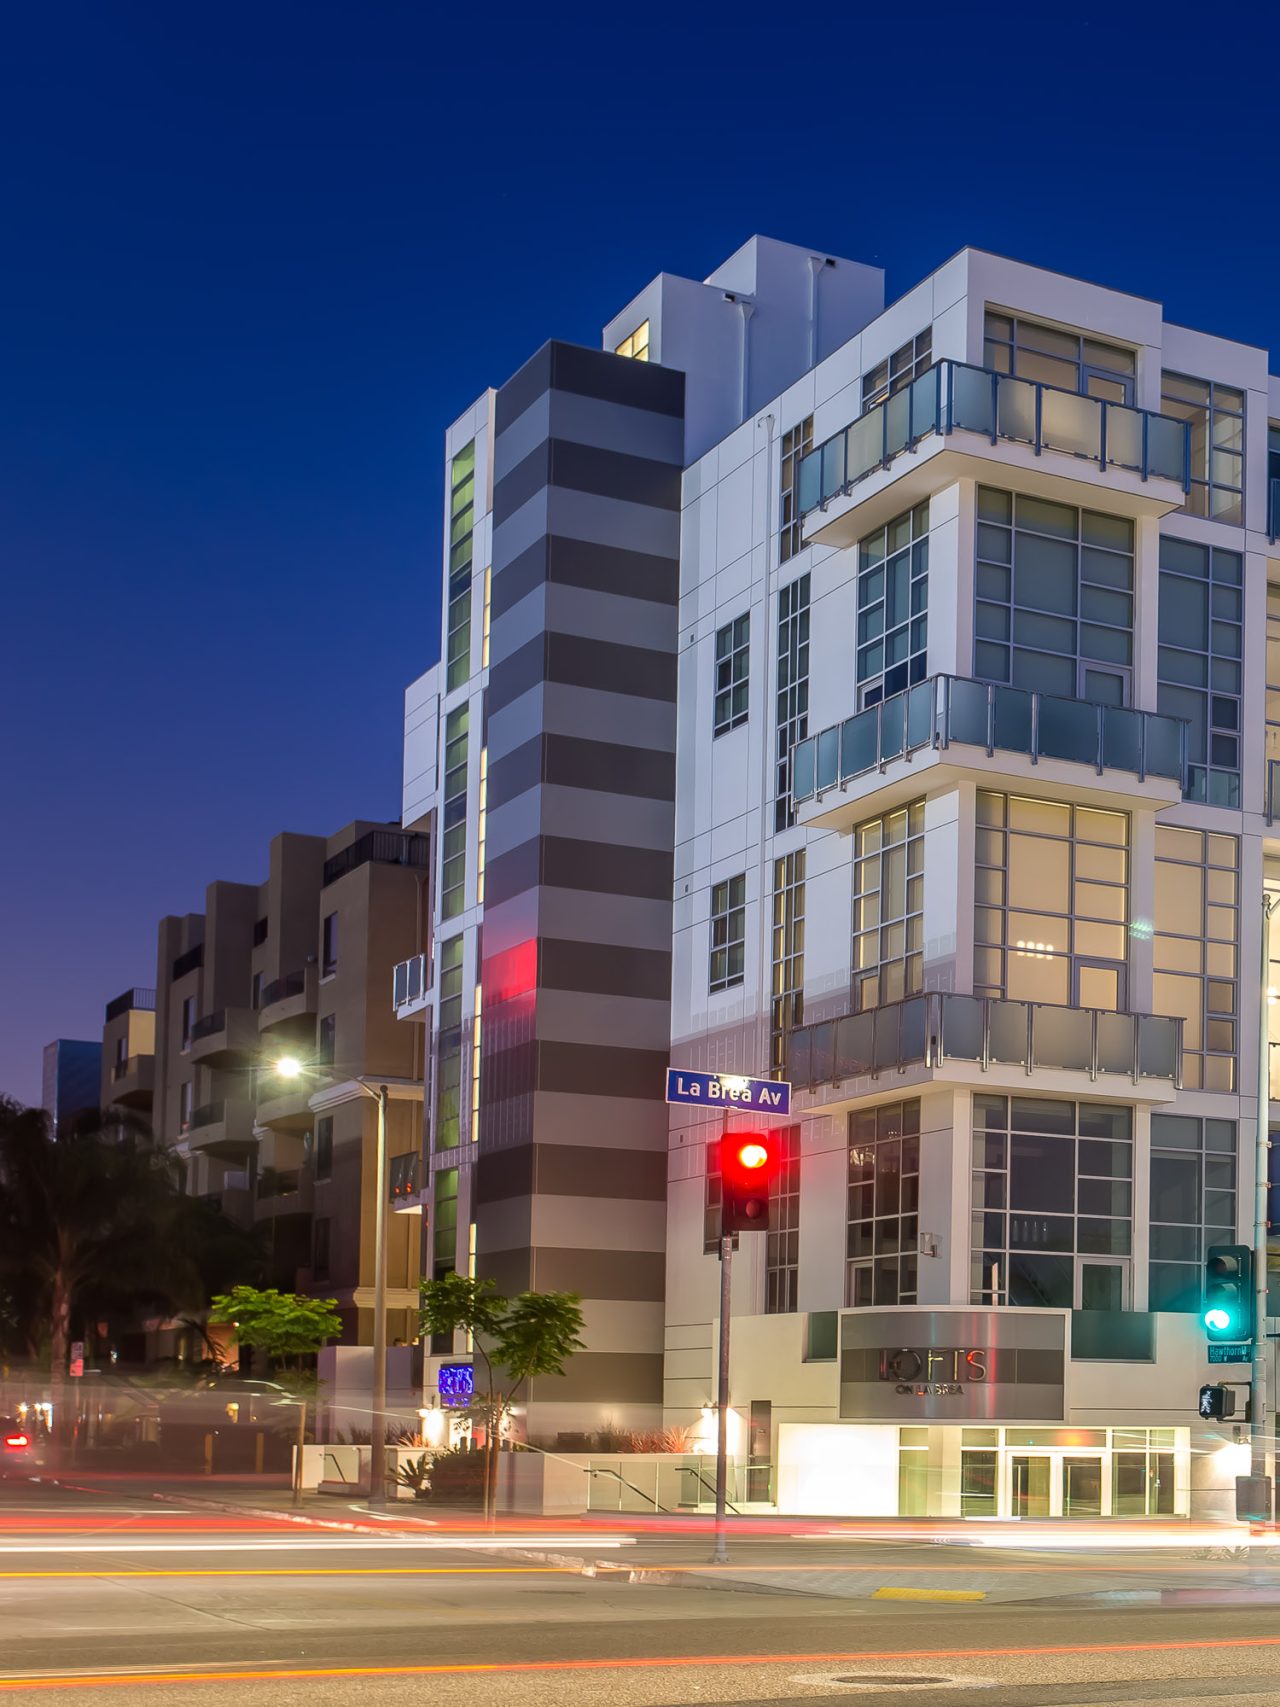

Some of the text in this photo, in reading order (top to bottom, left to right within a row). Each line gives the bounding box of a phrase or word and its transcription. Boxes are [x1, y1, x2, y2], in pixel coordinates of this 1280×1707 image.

[677, 1077, 782, 1106] La Brea Av
[879, 1349, 986, 1381] LOFTS
[895, 1384, 914, 1395] ON
[934, 1384, 964, 1395] BREA
